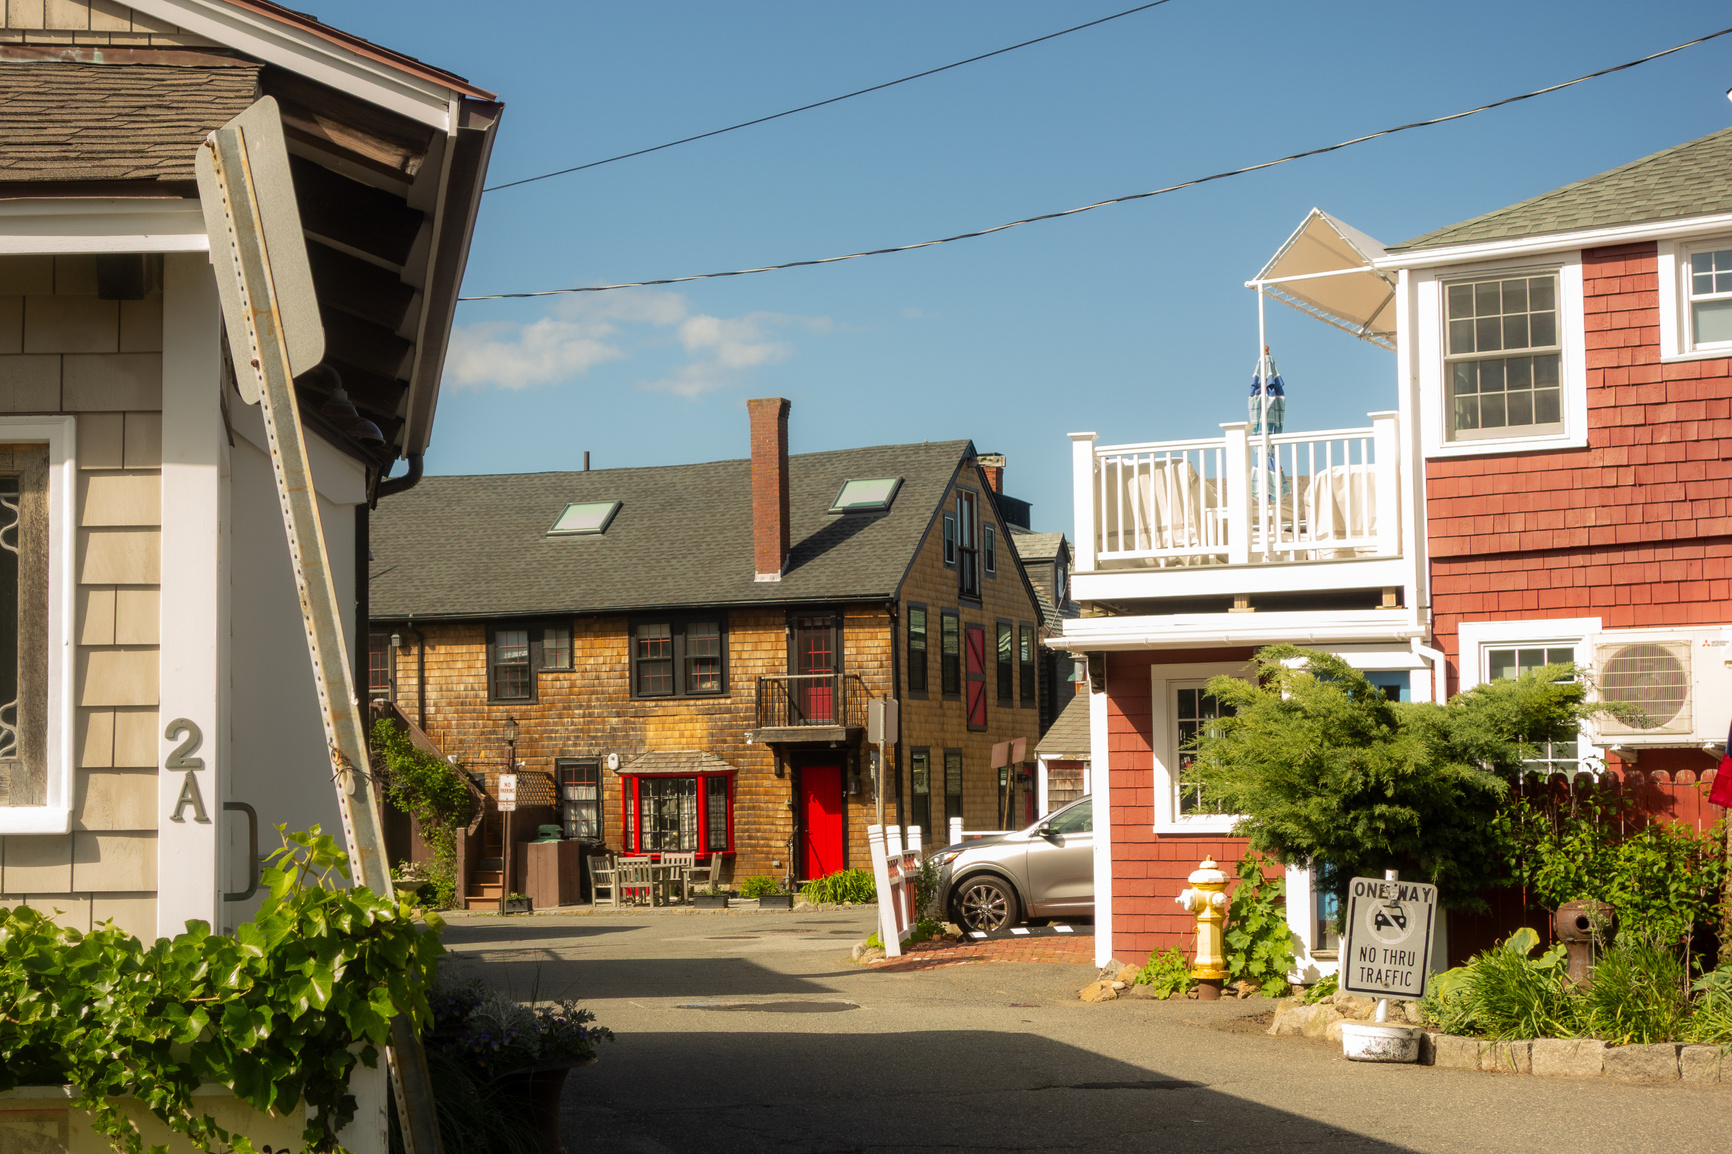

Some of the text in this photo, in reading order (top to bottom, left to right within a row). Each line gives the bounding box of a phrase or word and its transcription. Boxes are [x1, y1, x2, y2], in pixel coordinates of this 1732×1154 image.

[1355, 882, 1432, 903] ONE WAY
[1359, 946, 1415, 967] NO THRU
[1360, 967, 1412, 987] TRAFFIC
